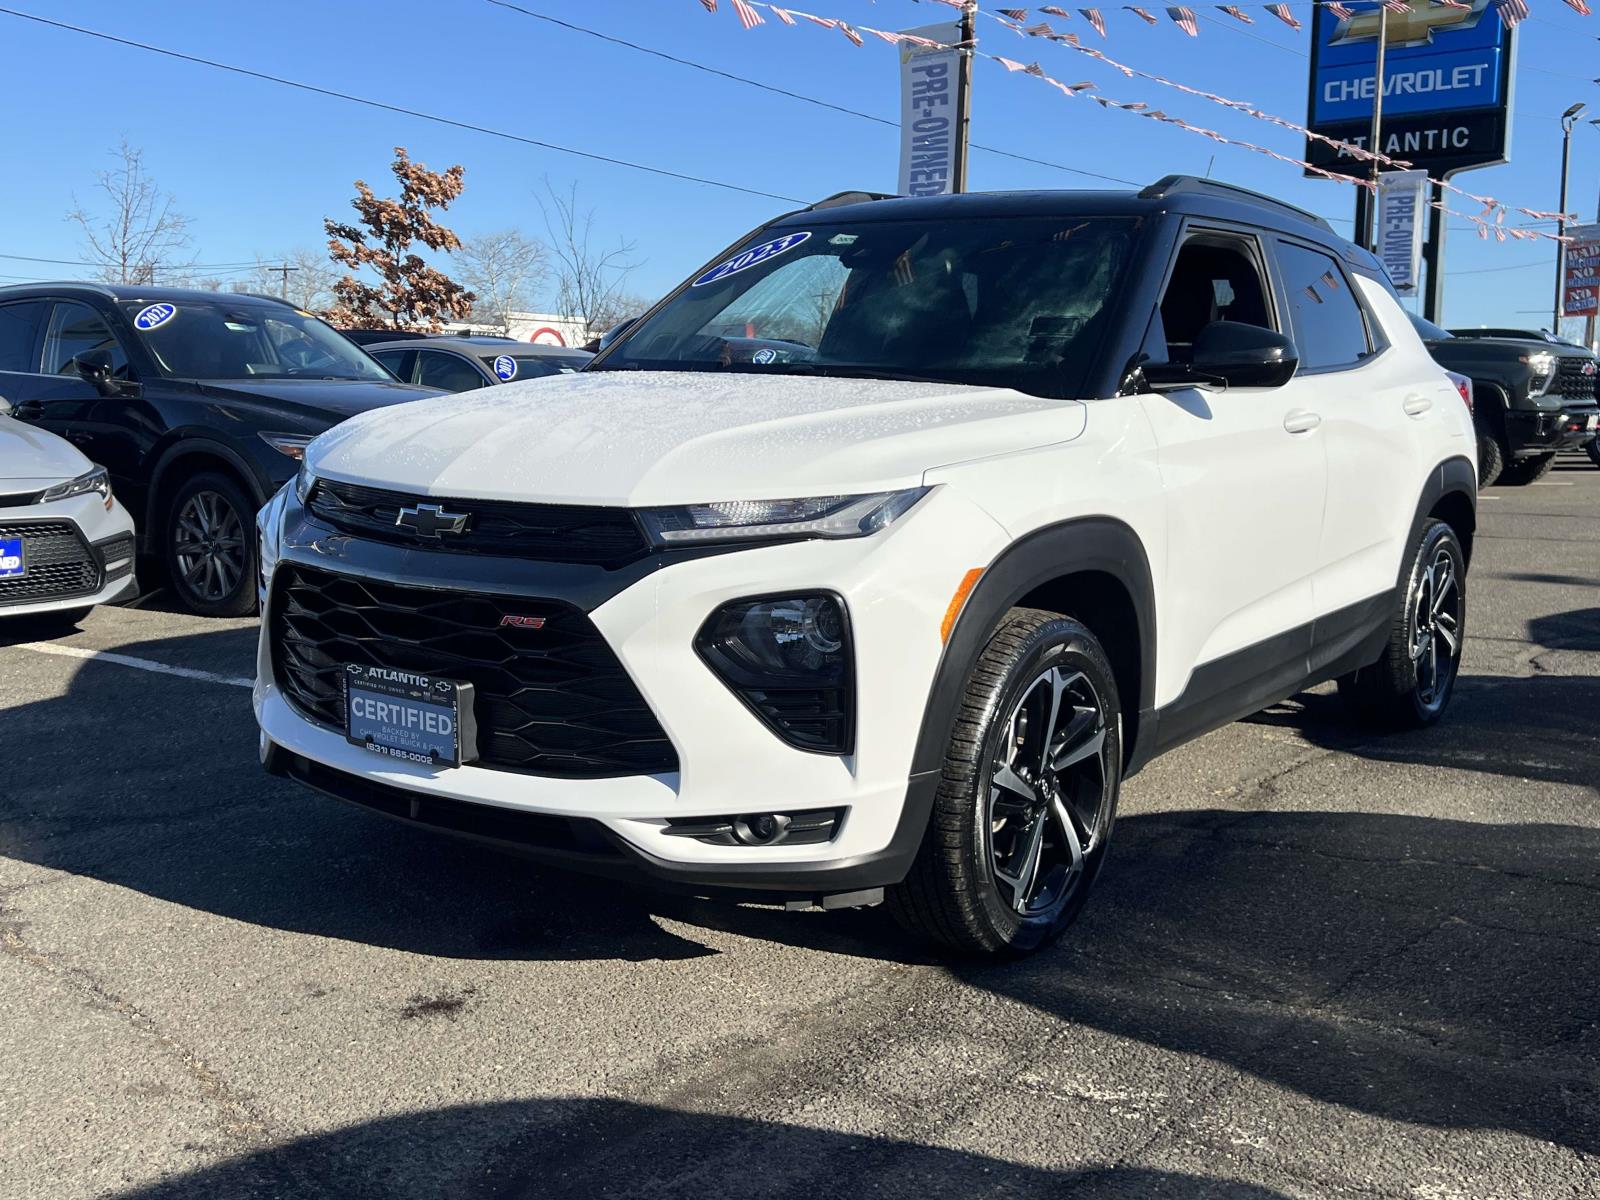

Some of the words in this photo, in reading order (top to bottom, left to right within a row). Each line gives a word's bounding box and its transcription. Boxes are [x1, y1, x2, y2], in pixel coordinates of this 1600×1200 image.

[1324, 63, 1489, 103] CHEVROLET
[909, 62, 950, 196] PRE-OWNED
[1337, 126, 1470, 158] ATANTIC
[711, 236, 793, 280] 2023
[141, 304, 170, 328] 2021
[500, 615, 546, 629] RS
[368, 667, 429, 688] ATLANTIC
[351, 696, 451, 736] CERTIFIED
[382, 726, 409, 738] BACKED
